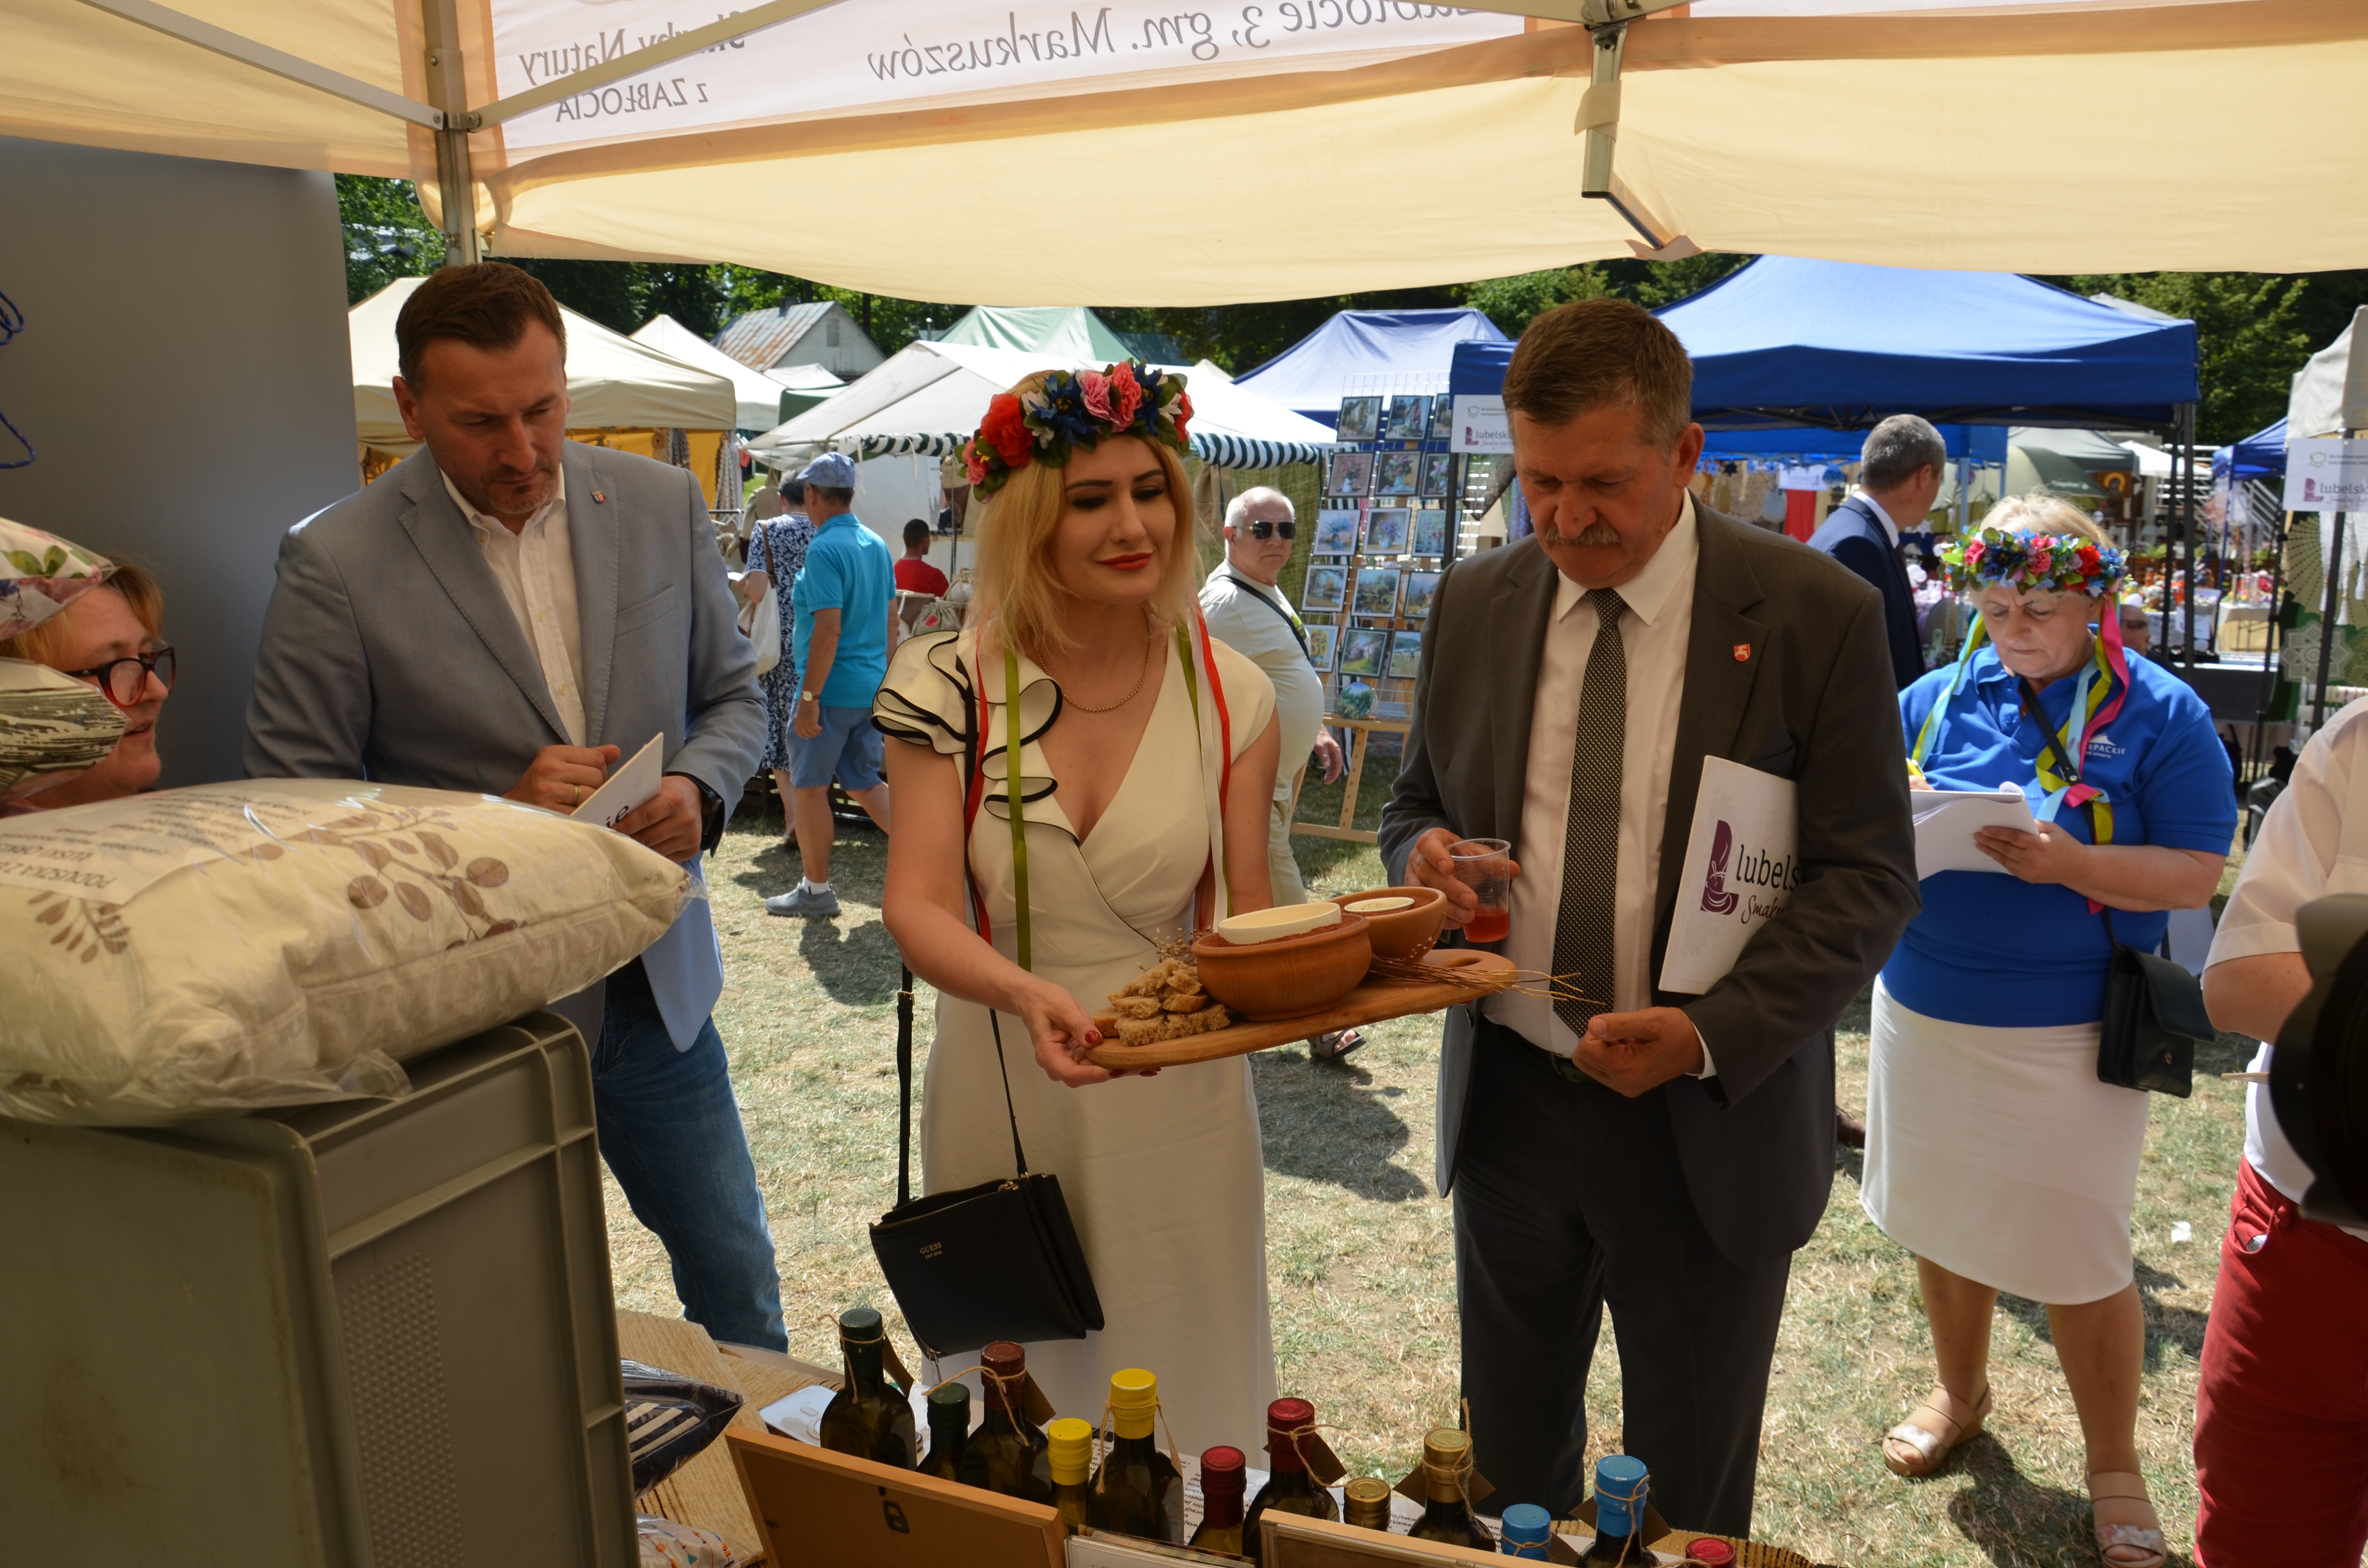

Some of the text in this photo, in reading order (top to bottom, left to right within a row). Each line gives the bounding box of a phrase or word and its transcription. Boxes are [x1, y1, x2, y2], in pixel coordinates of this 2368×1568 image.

[2087, 744, 2126, 755] RPACKIE
[1736, 844, 1801, 892] lubels
[1741, 894, 1785, 925] Smaku
[920, 1242, 942, 1254] GUESS
